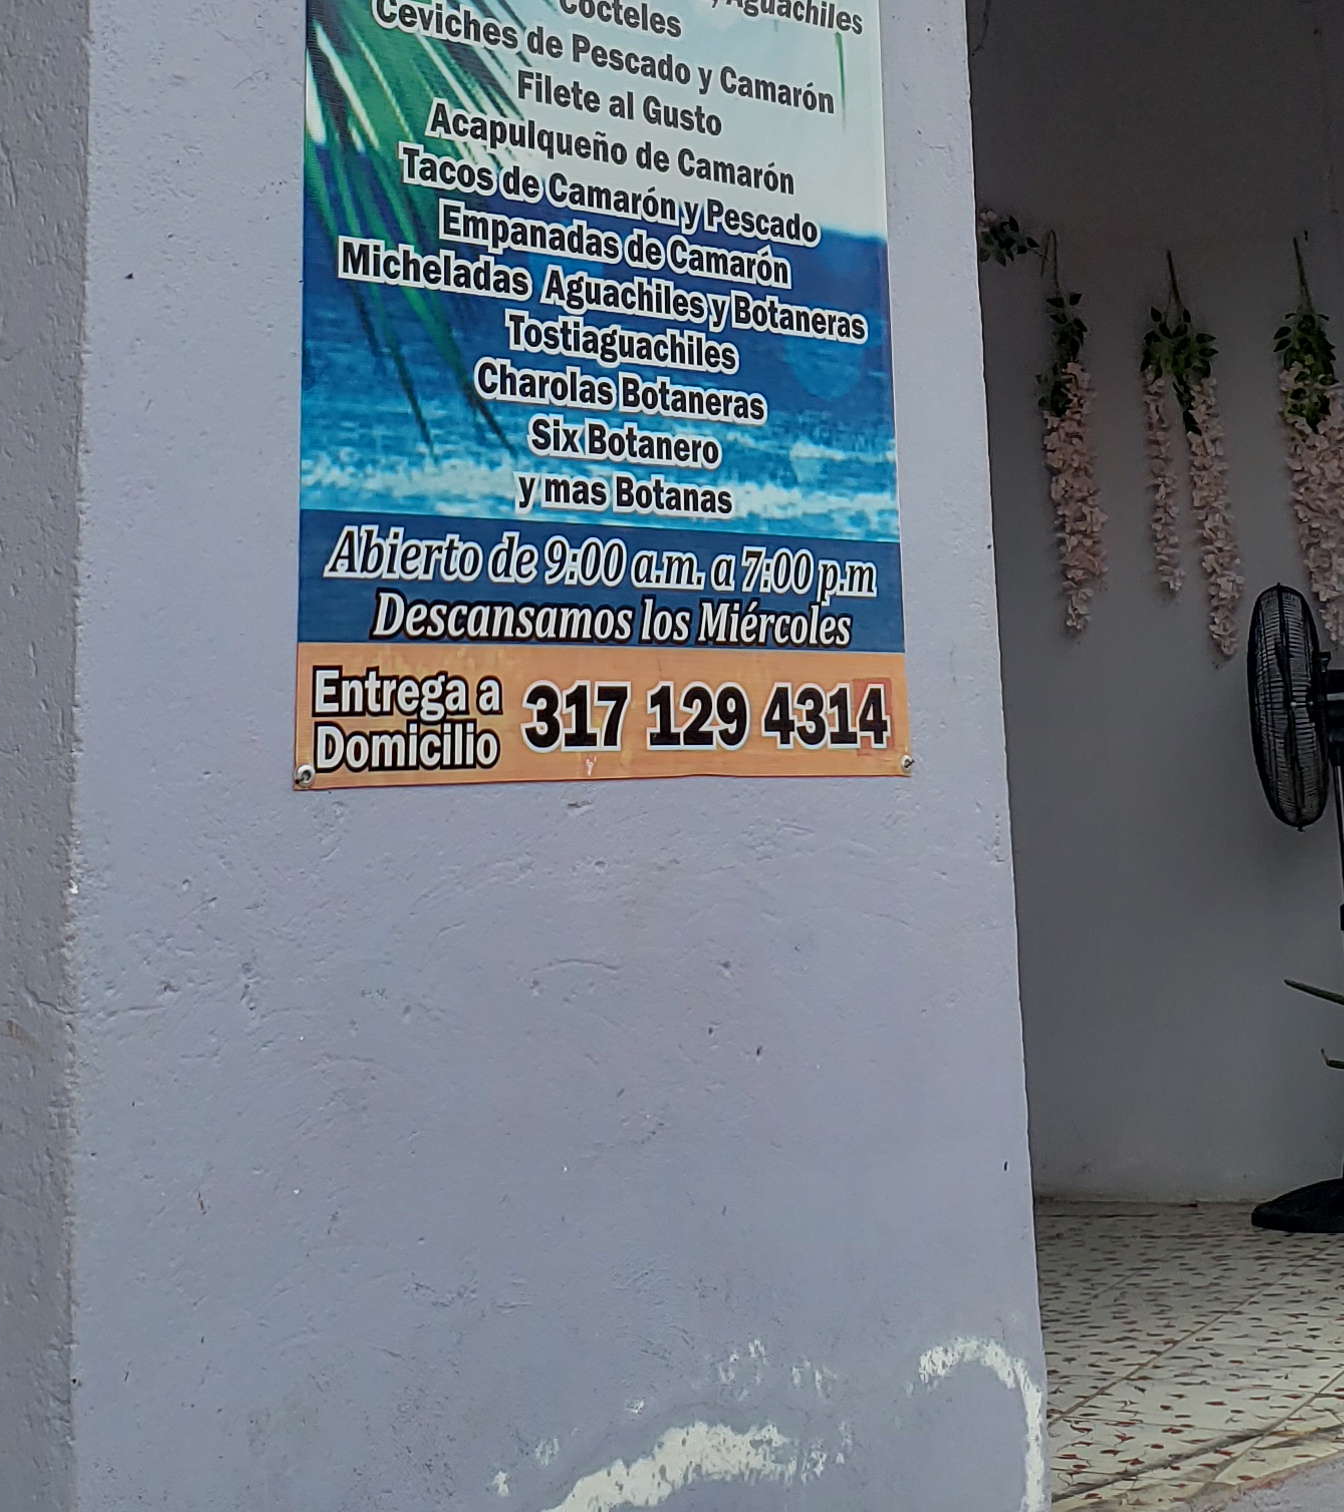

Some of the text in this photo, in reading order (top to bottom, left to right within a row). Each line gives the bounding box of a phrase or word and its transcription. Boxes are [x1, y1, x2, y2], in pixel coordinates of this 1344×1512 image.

[527, 25, 564, 59] de
[572, 34, 691, 86] Pescado
[698, 68, 712, 94] y
[720, 65, 835, 114] Camarón
[517, 70, 722, 136] Filete al Gusto
[429, 103, 795, 194] Acapulqueño de Camarón
[403, 146, 818, 245] Tacos de Camarón y Pescado
[442, 204, 789, 285] Empanadas de Camarón
[340, 240, 866, 341] Micheladas Aguachiles y Botaneras
[509, 313, 738, 371] Tostiaguachiles
[477, 361, 766, 421] Charolas Botaneras
[531, 419, 720, 466] Six Botanero
[518, 475, 734, 514] y mas Botanas
[327, 526, 878, 606] Abierto de 9:00 a.m. a 7:00 p.m
[373, 590, 852, 647] Descansamos los Miércoles
[312, 668, 502, 720] Entrega a
[522, 681, 892, 752] 317 129 4314
[314, 722, 500, 773] Domicilio
